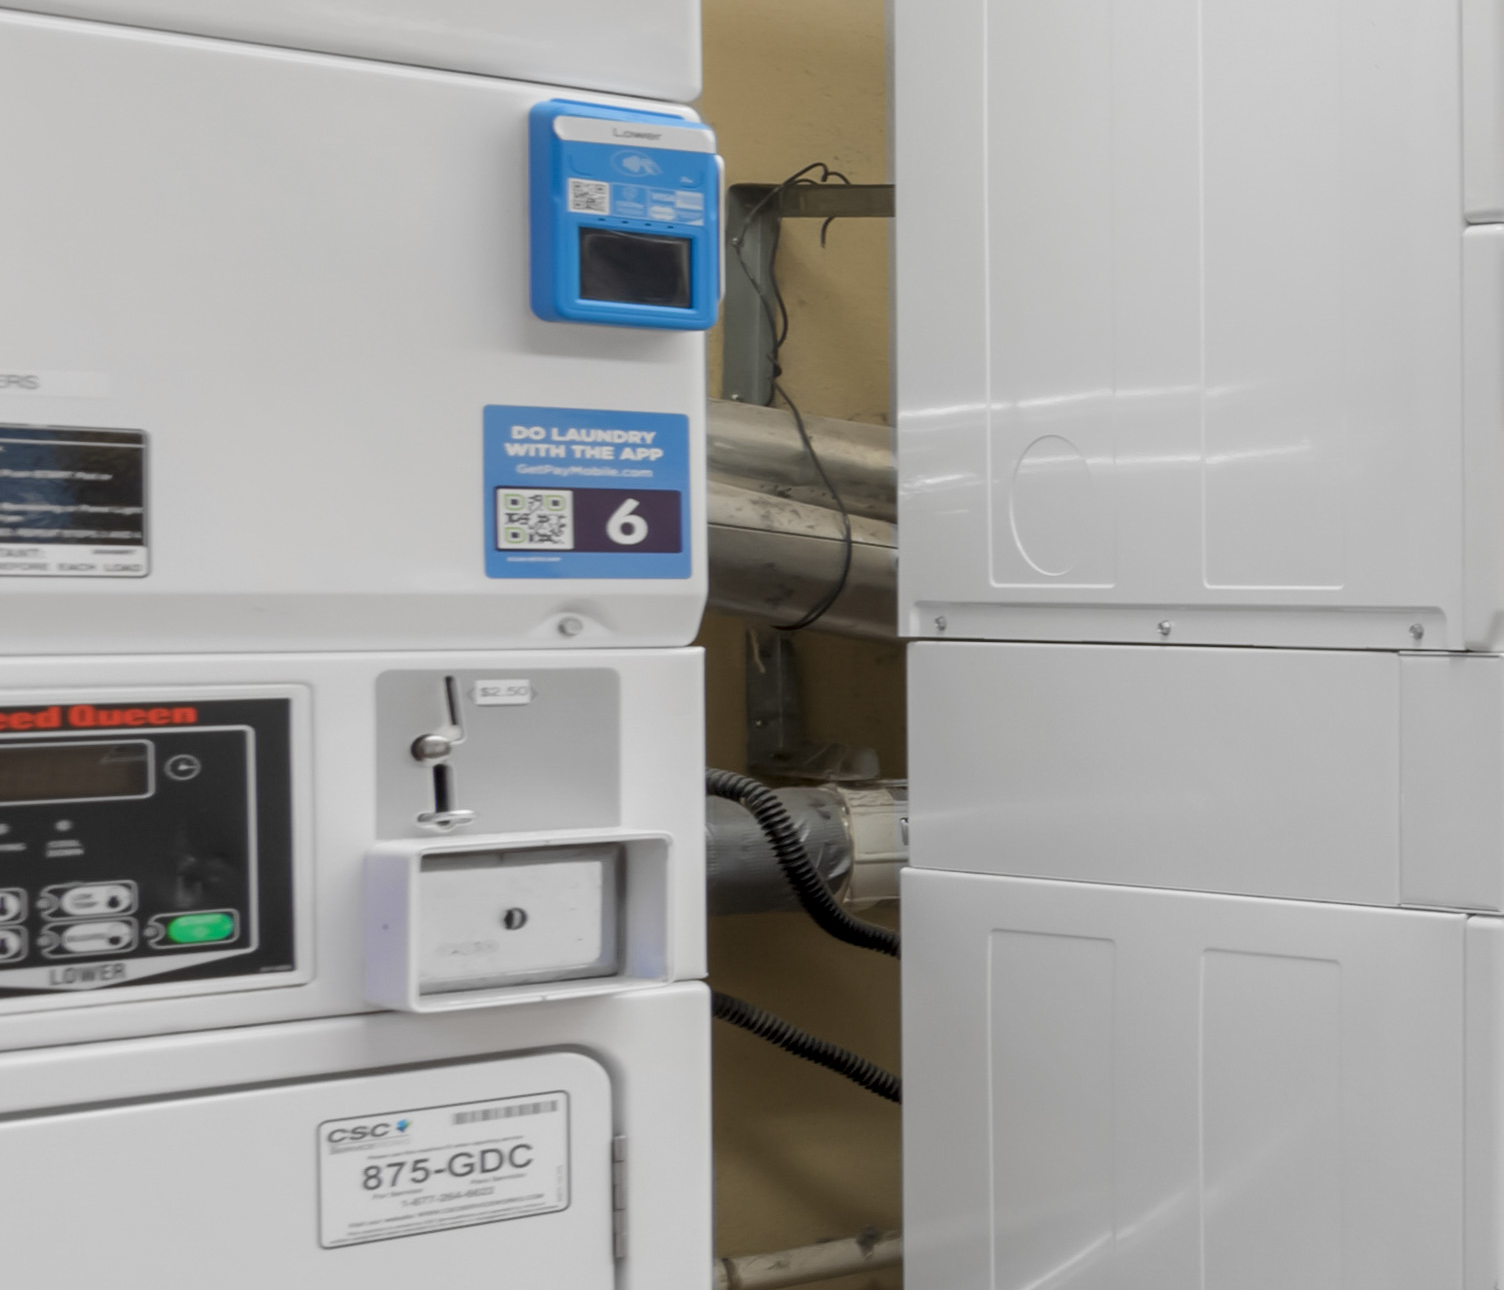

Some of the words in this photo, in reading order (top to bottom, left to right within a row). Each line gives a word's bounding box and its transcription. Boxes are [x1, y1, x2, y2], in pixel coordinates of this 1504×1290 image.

[612, 127, 662, 141] Lower
[511, 425, 546, 441] DO
[552, 428, 656, 444] LAUNDRY
[505, 443, 566, 458] WITH
[571, 445, 614, 460] THE
[620, 447, 664, 461] APP
[516, 463, 653, 478] GetPayMobile.com
[606, 498, 648, 545] 6
[480, 686, 528, 697] $2.50
[68, 704, 198, 728] Queen
[50, 963, 126, 986] LOWER
[327, 1122, 391, 1143] CSC
[362, 1143, 534, 1191] 875-GDC
